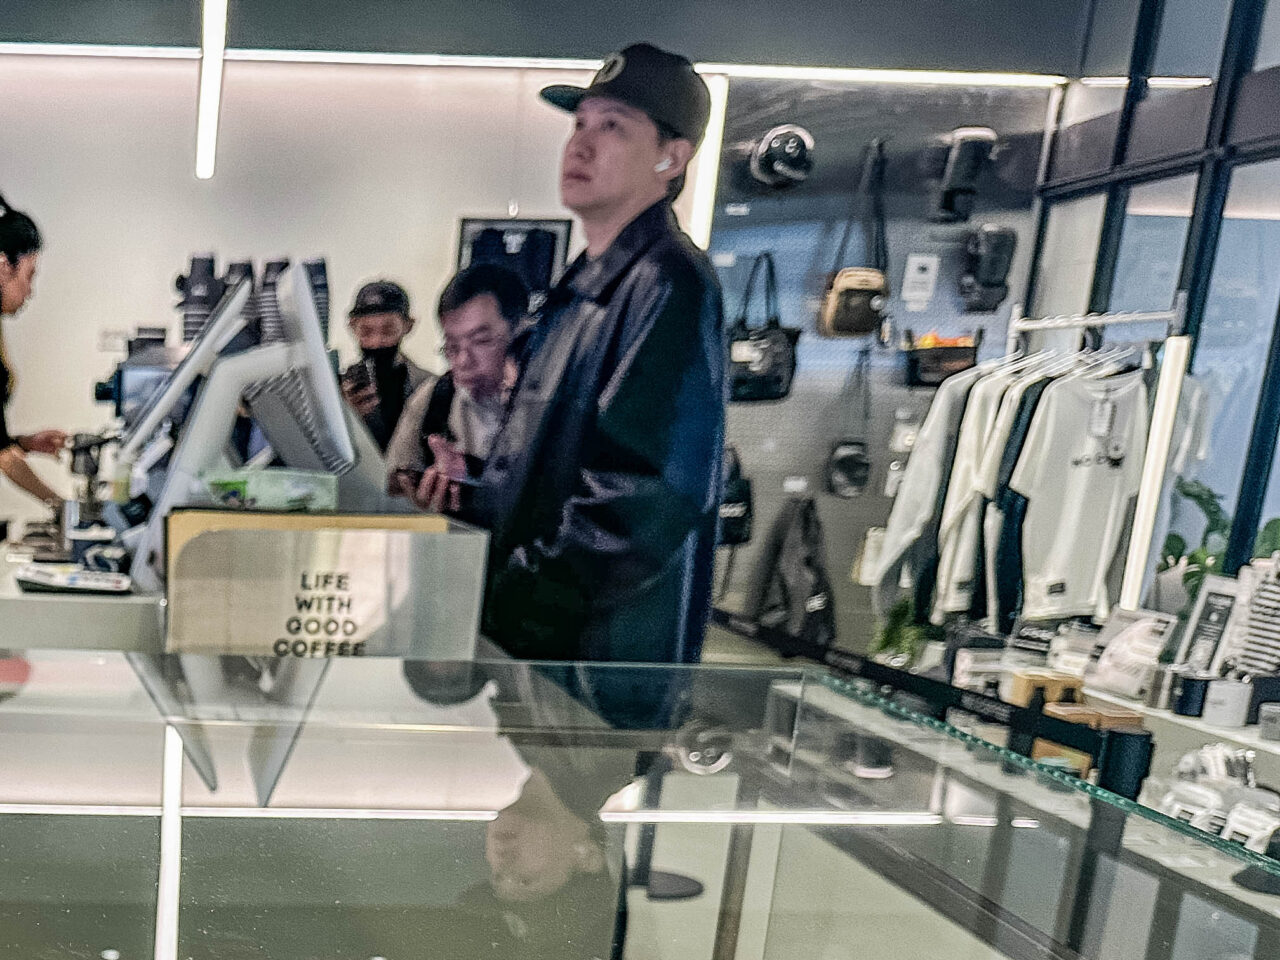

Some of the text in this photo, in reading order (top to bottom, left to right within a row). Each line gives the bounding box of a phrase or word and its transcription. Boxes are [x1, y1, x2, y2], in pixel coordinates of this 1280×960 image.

[300, 571, 351, 591] LIFE
[295, 597, 353, 614] WITH
[286, 618, 358, 636] GOOD
[273, 638, 368, 657] COFFEE
